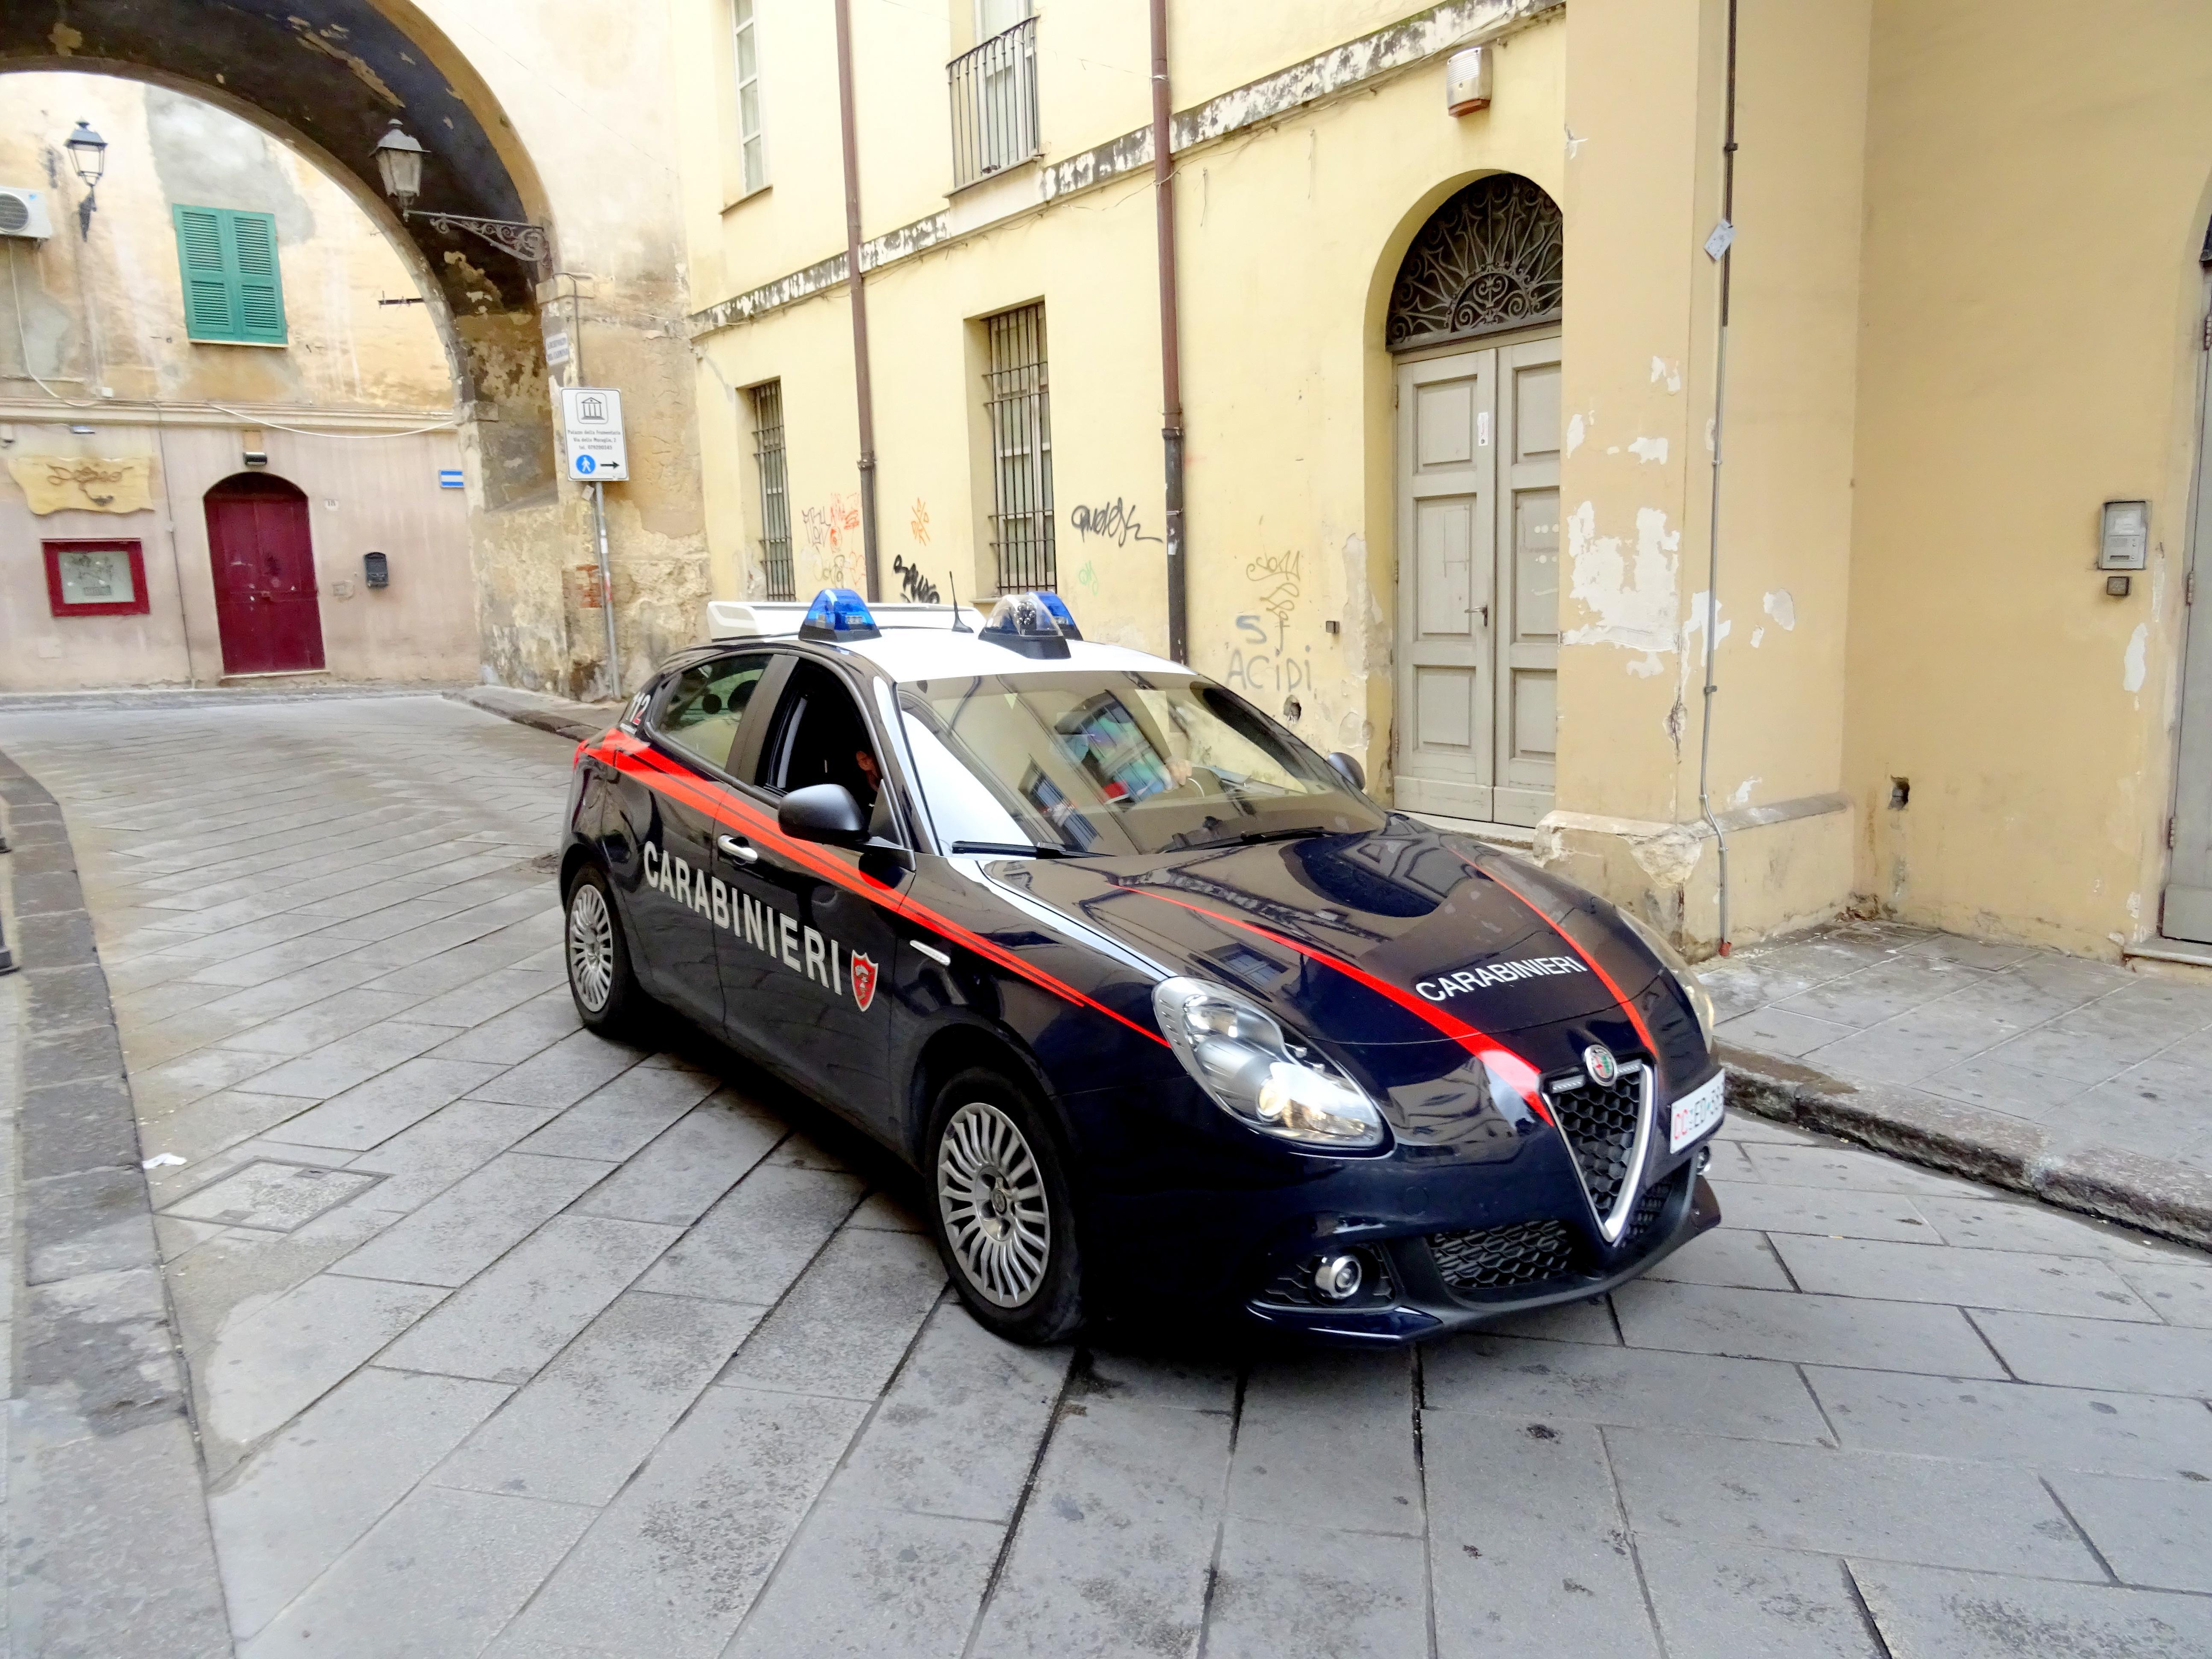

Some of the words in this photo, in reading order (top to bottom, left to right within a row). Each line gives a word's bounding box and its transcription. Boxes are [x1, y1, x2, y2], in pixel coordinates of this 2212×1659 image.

[626, 691, 651, 725] 112
[644, 841, 842, 996] CARABINIERI
[1415, 956, 1588, 1001] CARABINIERI
